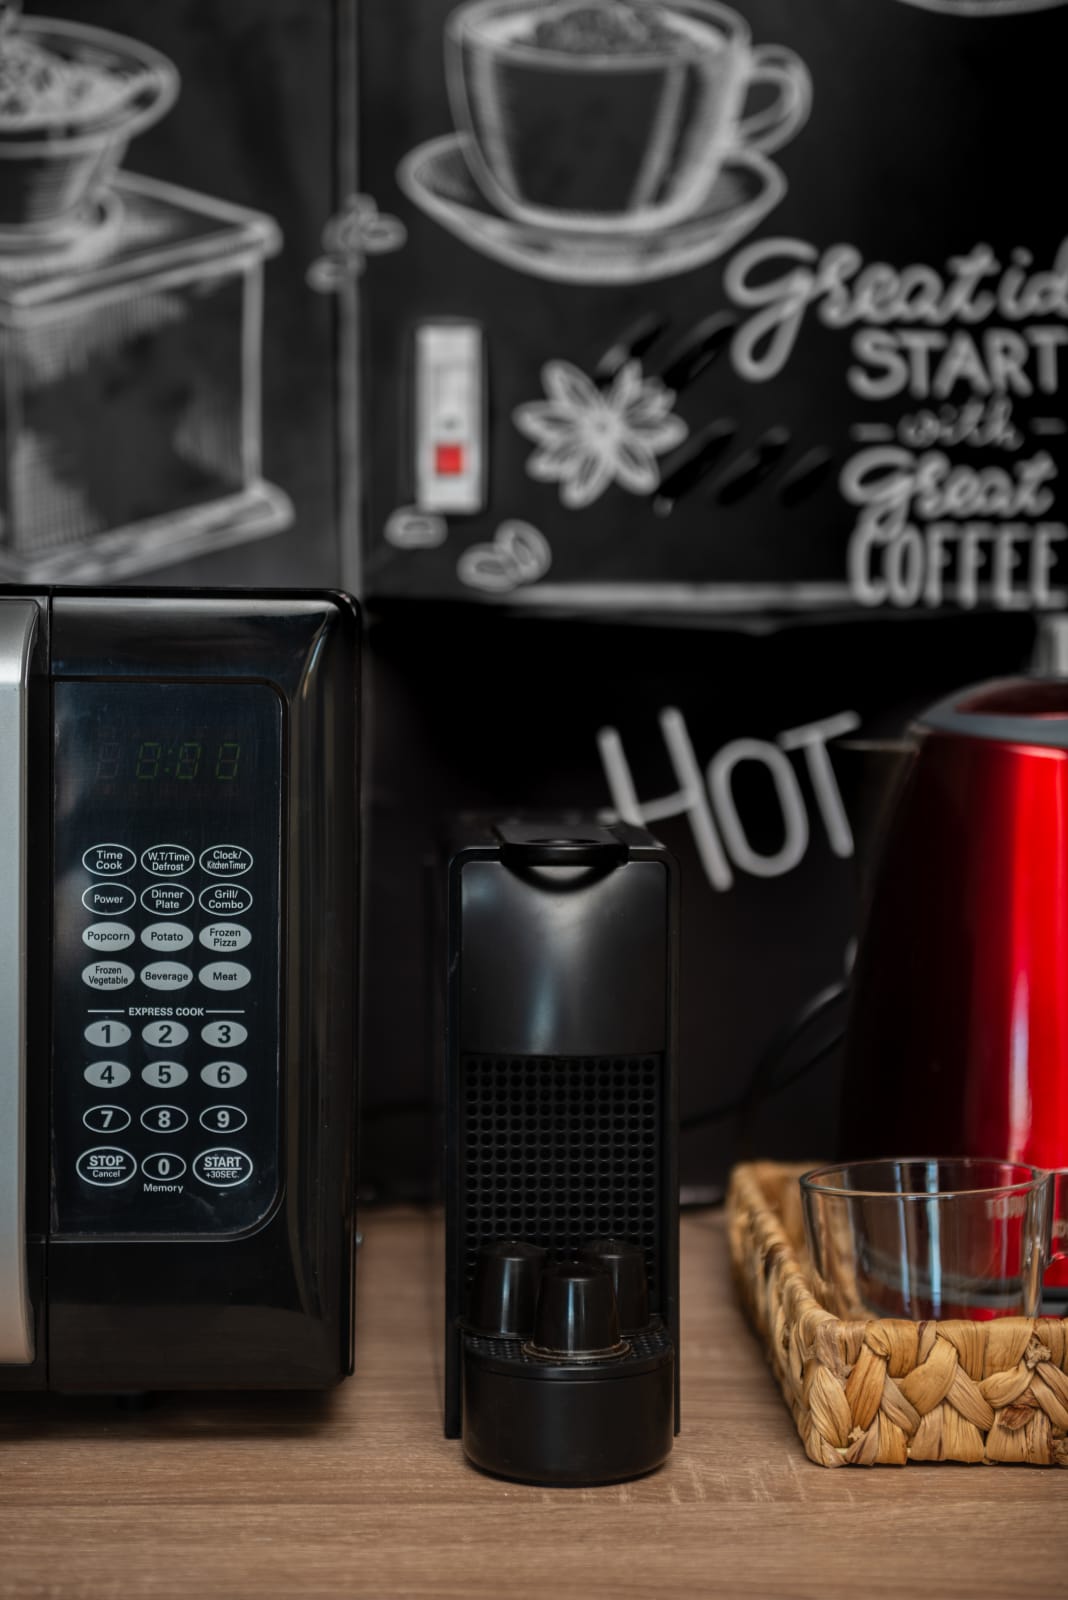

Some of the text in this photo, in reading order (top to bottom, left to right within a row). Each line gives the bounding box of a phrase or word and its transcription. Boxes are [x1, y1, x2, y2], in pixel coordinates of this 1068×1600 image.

[847, 324, 1068, 399] START
[846, 520, 1068, 609] COFFEE
[596, 705, 862, 893] HOT
[96, 850, 123, 860] Time
[213, 850, 242, 860] Clock/
[95, 860, 123, 870] Cook
[152, 862, 184, 871] Defrost
[94, 894, 124, 904] Power
[151, 889, 184, 899] Dinner
[214, 890, 238, 899] Grill/
[155, 900, 180, 909] Plate
[208, 900, 244, 909] Combo
[87, 931, 130, 943] Popcorn
[150, 931, 184, 941] Potato
[209, 928, 241, 937] Frozen
[213, 938, 237, 947] Pizza
[95, 965, 122, 975] Frozen
[88, 975, 129, 986] Vegetable
[145, 972, 189, 983] Beverage
[212, 972, 237, 981] Meat
[128, 1007, 204, 1016] EXPRESS COOK
[101, 1024, 111, 1044] 1
[158, 1024, 173, 1044] 2
[217, 1024, 232, 1044] 3
[99, 1065, 115, 1084] 4
[157, 1065, 172, 1084] 5
[217, 1065, 231, 1084] 6
[100, 1110, 113, 1128] 7
[157, 1110, 171, 1128] 8
[216, 1110, 231, 1128] 9
[89, 1155, 124, 1166] STOP
[204, 1156, 243, 1168] START
[157, 1158, 170, 1176] 0
[92, 1169, 121, 1178] Cancel
[143, 1183, 184, 1194] Memory
